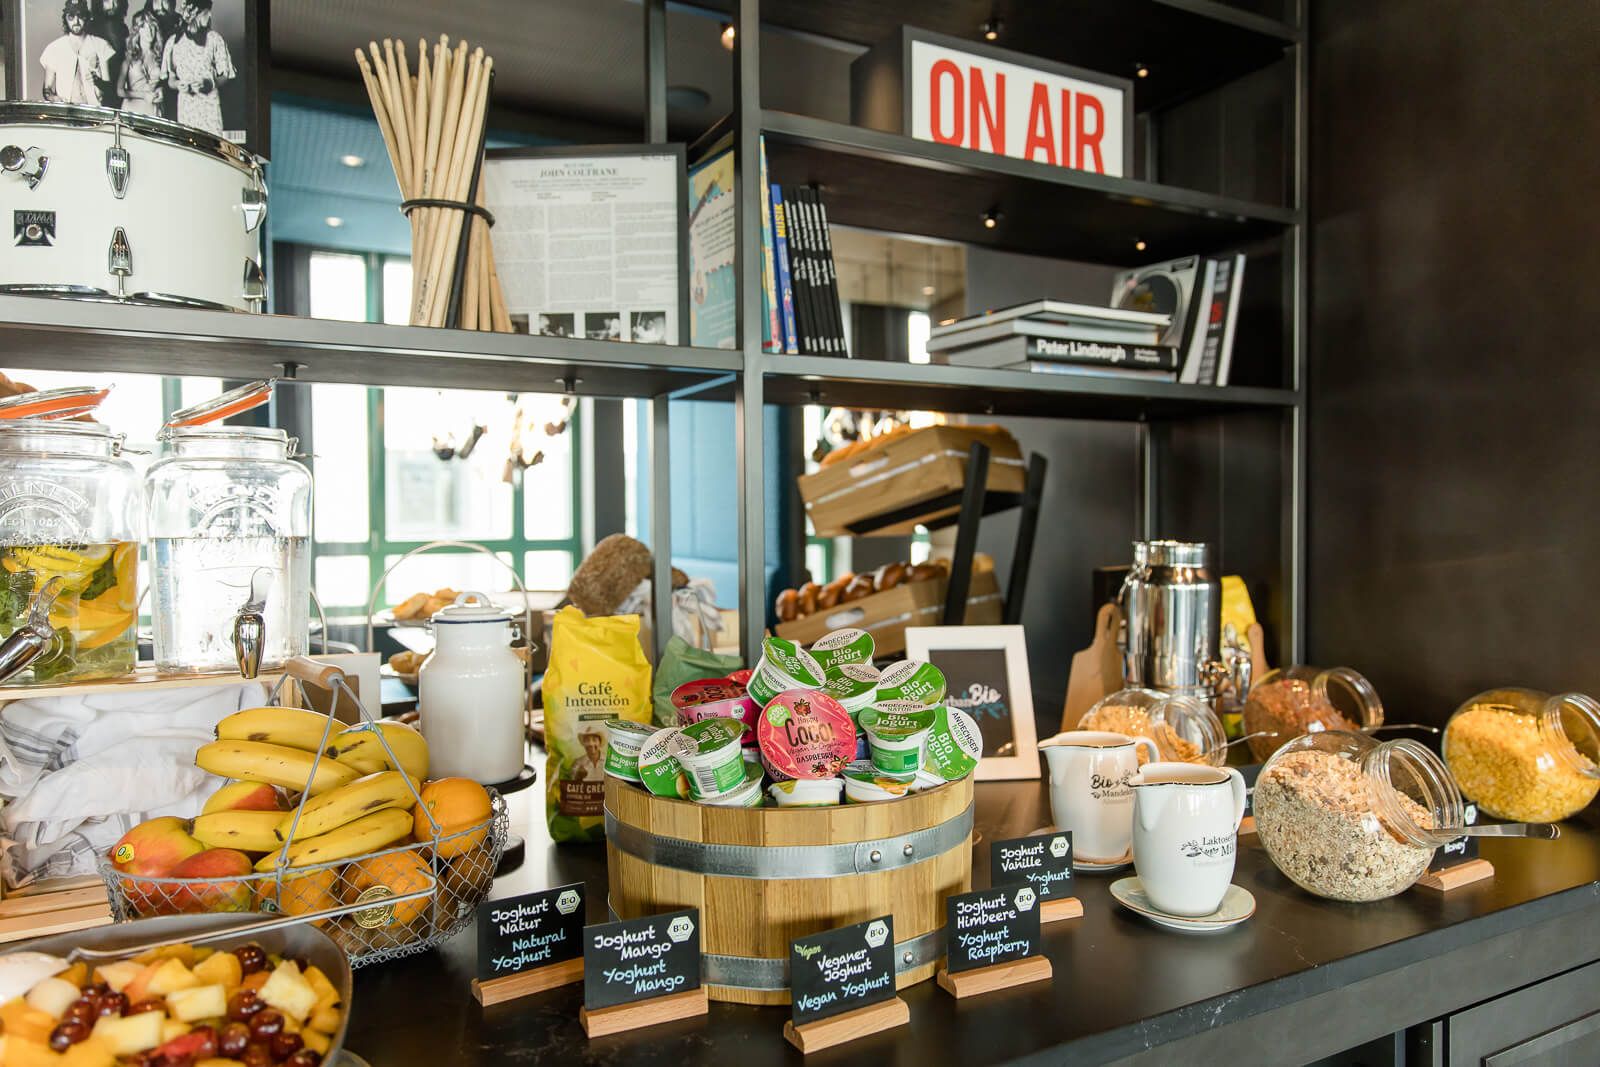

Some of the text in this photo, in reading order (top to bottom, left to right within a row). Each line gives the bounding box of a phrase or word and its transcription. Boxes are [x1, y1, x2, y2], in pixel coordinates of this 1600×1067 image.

[930, 59, 1105, 175] ON AIR
[1036, 338, 1127, 363] Peter Lindbergh
[818, 631, 859, 648] ANDECHSER
[826, 650, 861, 669] Jogurt
[832, 648, 852, 658] Bio
[880, 661, 917, 686] ANDECHSER
[578, 681, 613, 696] Café
[900, 680, 920, 695] Bio
[565, 695, 630, 707] Intención
[938, 732, 954, 754] Bio
[952, 712, 979, 753] ANDECHSER
[796, 752, 834, 763] RASPBERRY
[1090, 774, 1113, 789] Bio
[1000, 842, 1045, 861] Joghurt
[1001, 856, 1043, 873] Vanille
[491, 899, 550, 923] Joghurt
[957, 893, 1008, 916] Joghurt
[500, 917, 542, 937] Natur
[957, 909, 1017, 929] Himbeere
[512, 928, 567, 953] Natural
[594, 925, 656, 950] Joghurt
[958, 925, 1010, 948] Yoghurt
[491, 945, 552, 972] Yoghurt
[620, 942, 672, 961] Mango
[817, 948, 868, 972] Veganer
[968, 940, 1030, 964] Raspberry
[603, 959, 667, 984] Yoghurt
[824, 957, 872, 982] Joghurt
[634, 975, 685, 994] Mango
[798, 971, 890, 1012] Vegan Yoghurt
